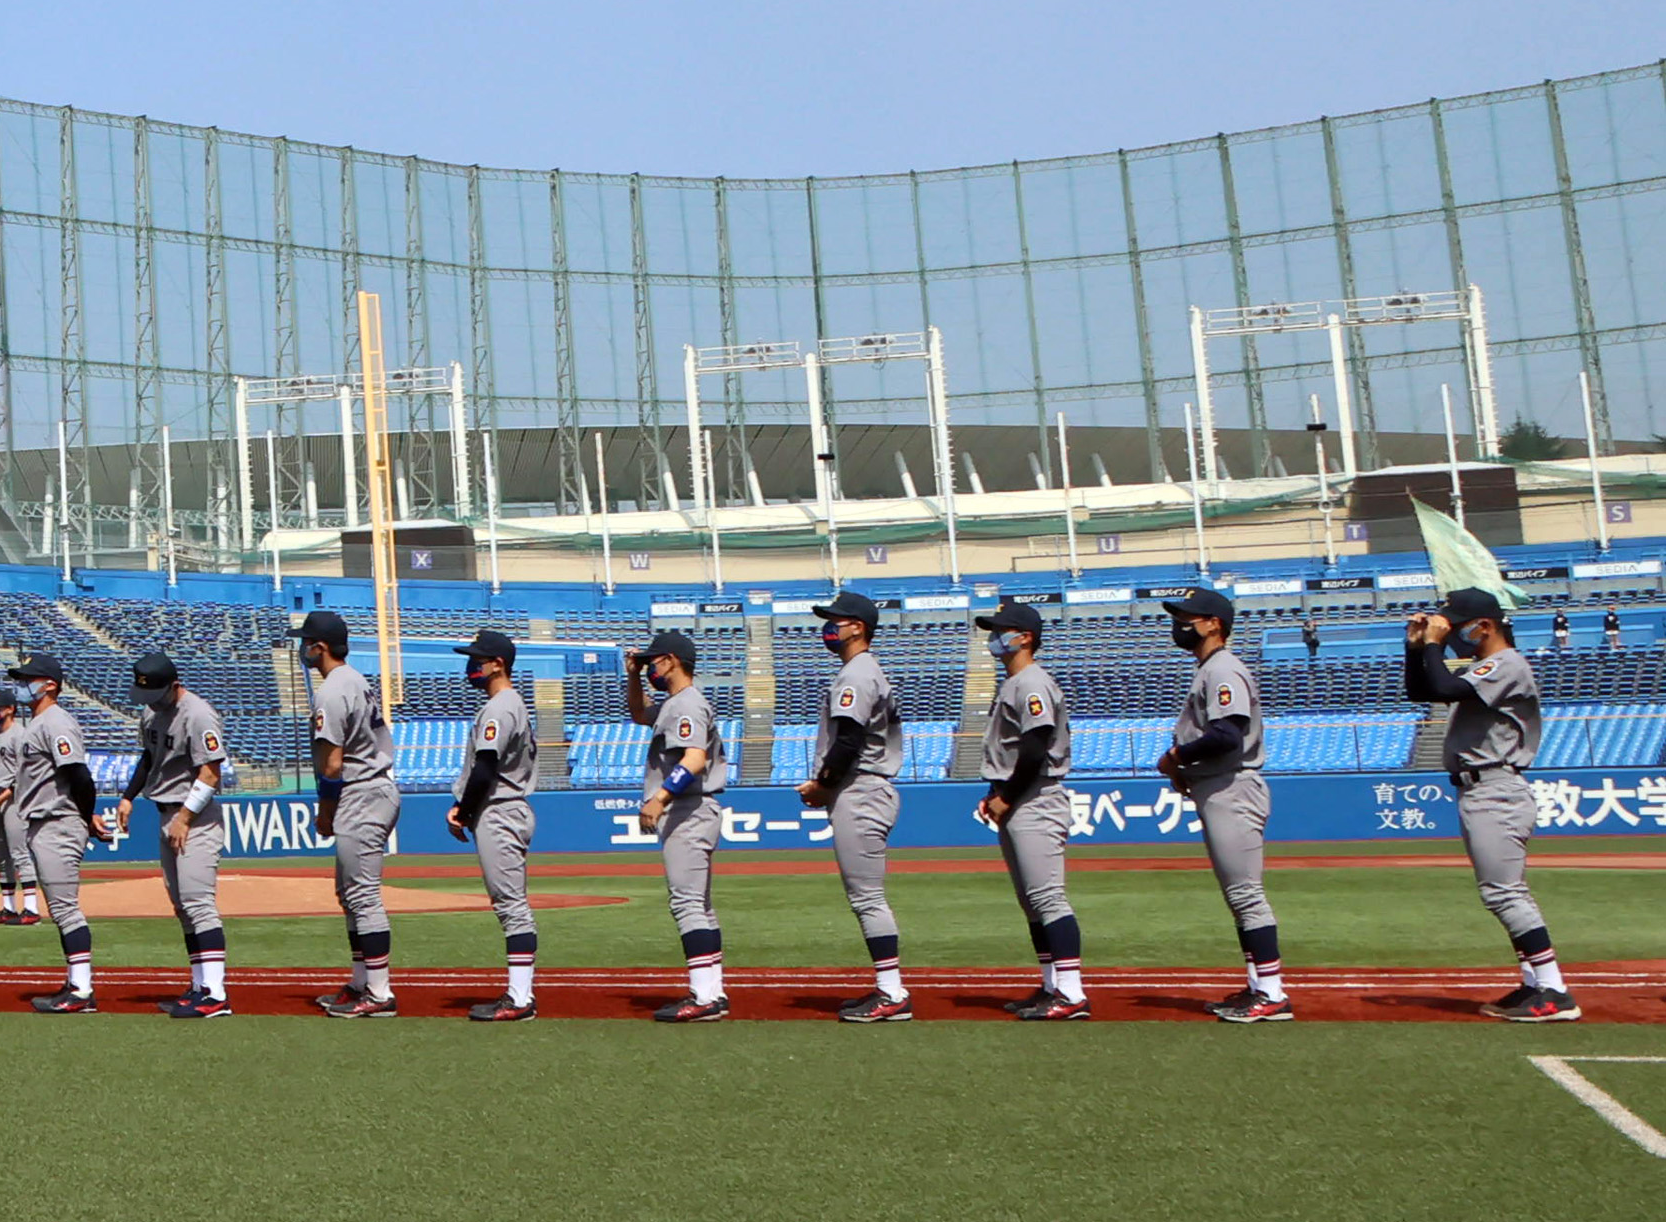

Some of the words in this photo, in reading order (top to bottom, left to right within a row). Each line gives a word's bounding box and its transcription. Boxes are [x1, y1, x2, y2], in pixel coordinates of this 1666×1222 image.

[1613, 505, 1625, 522] S
[1348, 524, 1361, 539] T
[1101, 537, 1114, 552] U
[415, 553, 427, 567] X
[630, 554, 649, 568] W
[869, 547, 883, 563] V
[1596, 564, 1639, 574] SEDIA
[1249, 582, 1287, 592] SEDIA
[919, 598, 955, 607] SEDIA
[1081, 591, 1118, 600] SEDIA
[657, 605, 689, 614] SEDIA
[1372, 782, 1454, 805] 育ての、
[594, 799, 644, 811] 低燃費タイ
[1375, 808, 1437, 830] 文教。
